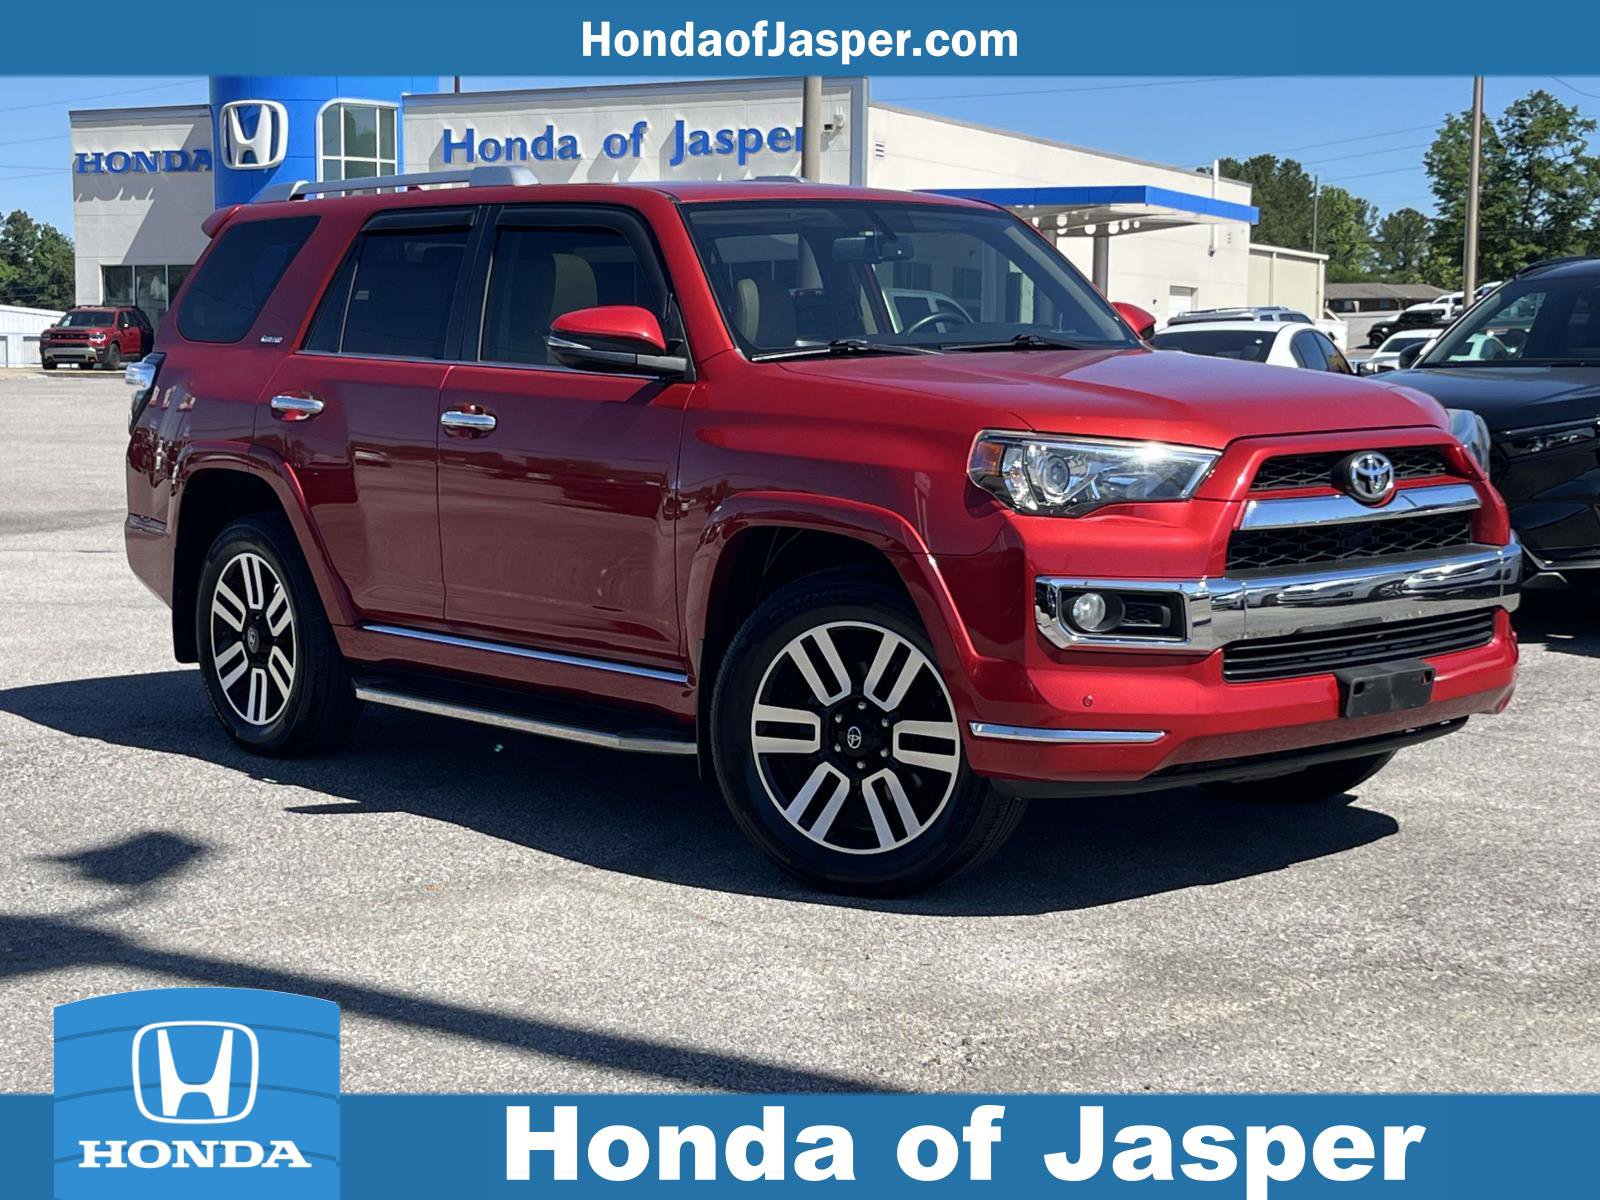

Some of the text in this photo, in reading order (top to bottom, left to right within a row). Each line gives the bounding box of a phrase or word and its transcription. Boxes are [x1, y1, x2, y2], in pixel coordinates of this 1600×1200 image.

[443, 125, 581, 164] Honda
[603, 121, 648, 159] of
[75, 149, 212, 174] HONDA
